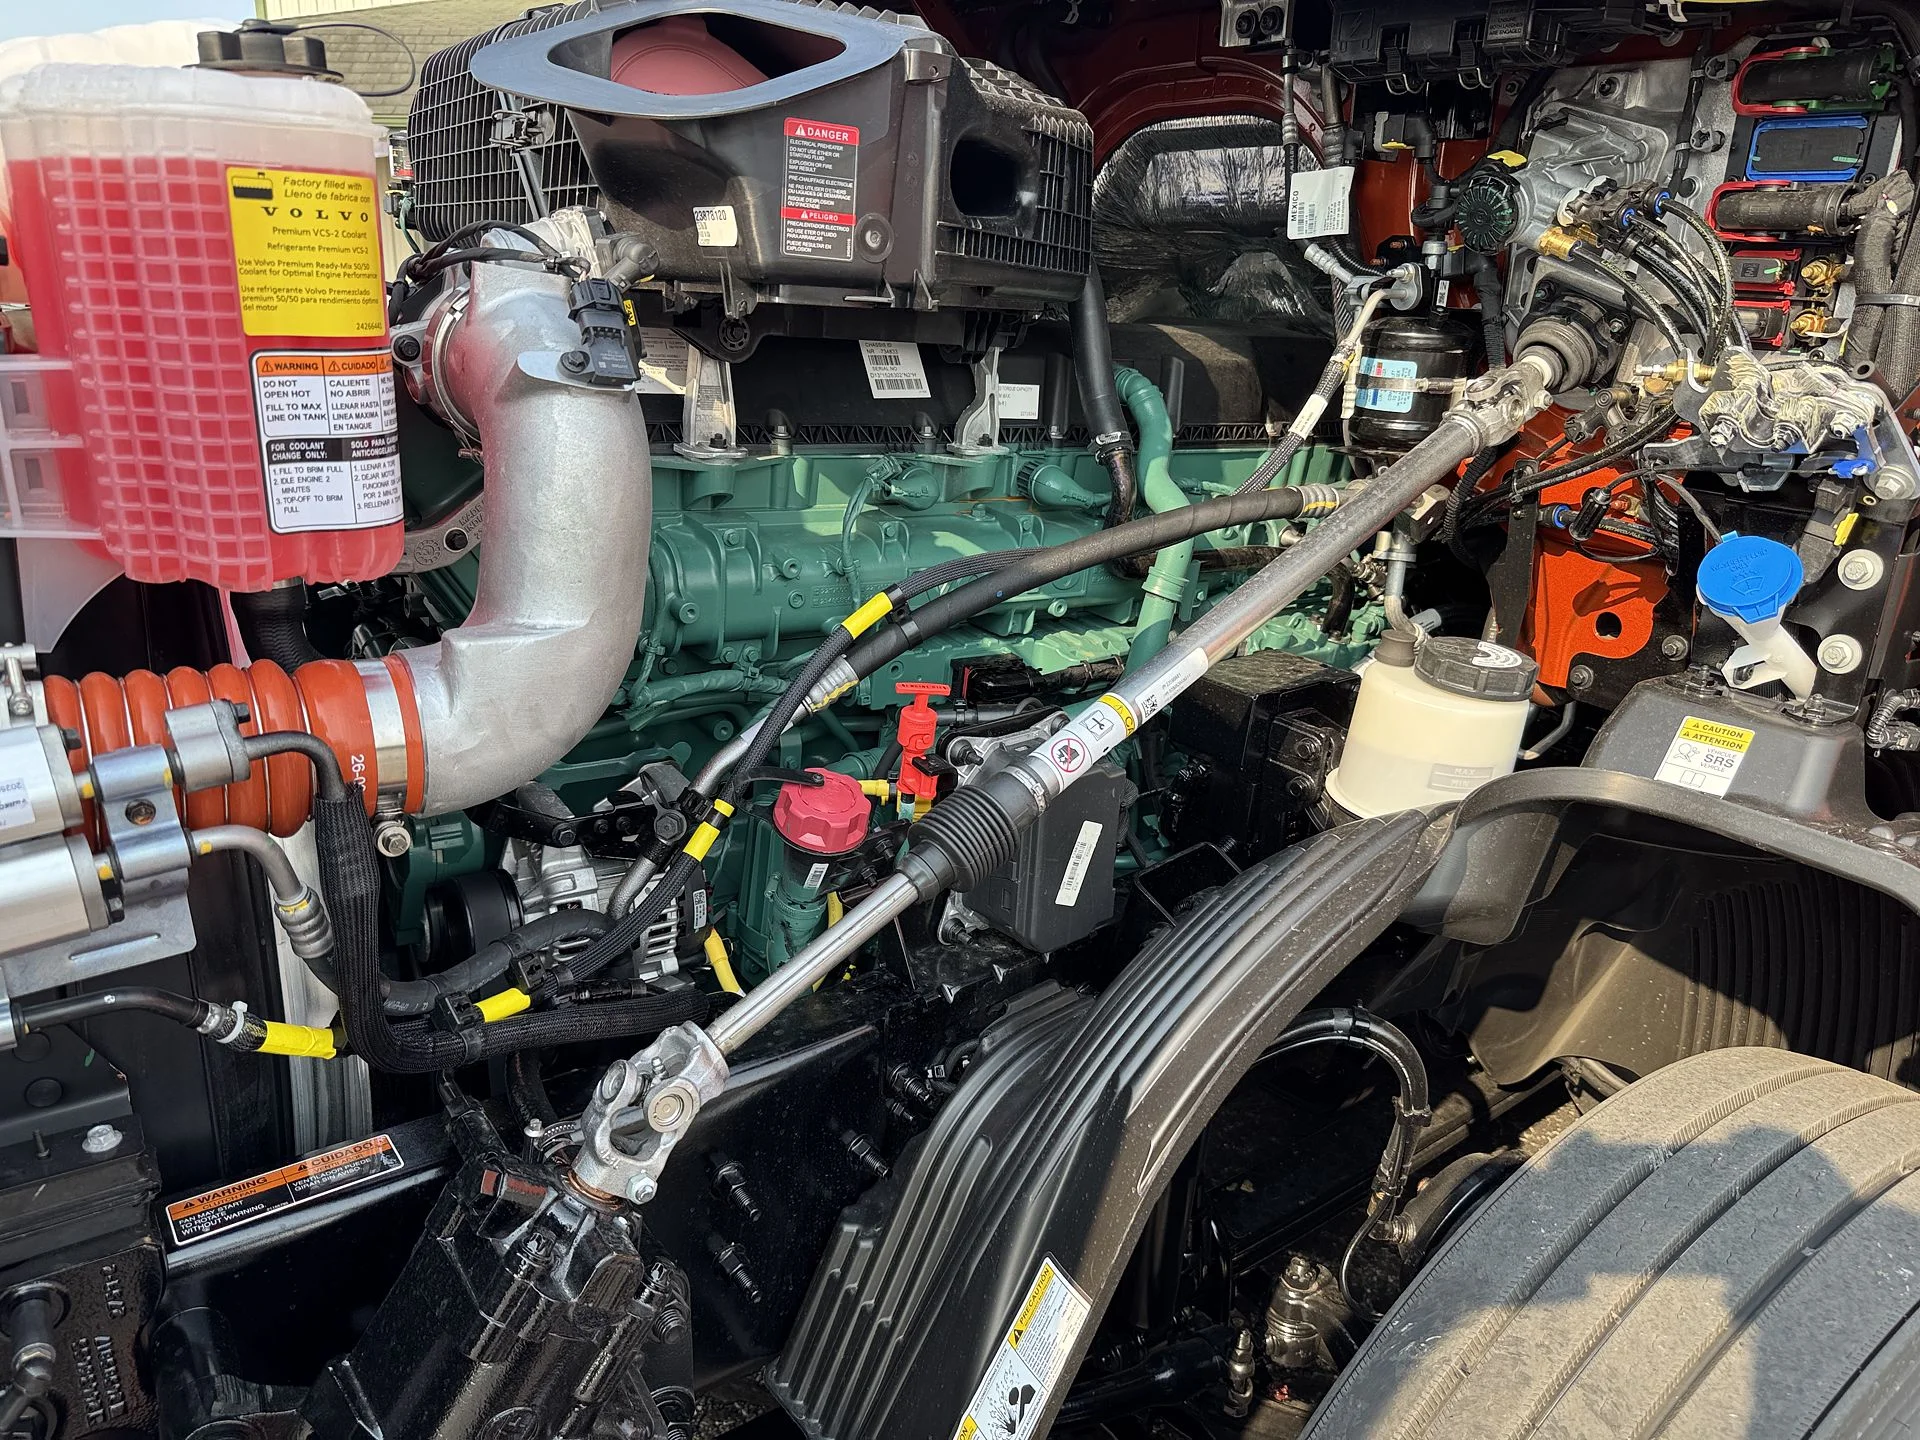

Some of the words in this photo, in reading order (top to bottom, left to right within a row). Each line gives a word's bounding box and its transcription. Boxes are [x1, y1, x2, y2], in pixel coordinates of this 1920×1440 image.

[808, 128, 848, 141] DANGER
[790, 139, 816, 147] ELECTRICAL
[817, 143, 843, 151] PREHEATER
[789, 159, 814, 167] EXPLOSION
[284, 177, 321, 188] Factory
[324, 178, 345, 189] filled
[348, 181, 362, 190] with
[285, 189, 312, 199] Lleno
[316, 191, 327, 200] de
[330, 193, 358, 202] fabrica
[1291, 190, 1299, 221] MEXICO
[262, 207, 368, 222] VOLVO
[809, 213, 838, 221] PELIGRO
[787, 220, 824, 229] PRECALENTADOR
[273, 227, 311, 236] Premium
[314, 229, 339, 237] VCS-2
[342, 231, 367, 239] Coolant
[268, 243, 316, 252] Refrigerante
[318, 245, 351, 253] Premium
[352, 246, 368, 254] VCS-2
[283, 269, 313, 278] Optimal
[316, 271, 341, 279] Engine
[257, 286, 304, 294] refrigerante
[276, 295, 298, 303] 50/50
[320, 297, 361, 305] rendimiento
[625, 304, 634, 322] 24V
[274, 362, 318, 370] WARNING
[342, 362, 376, 370] CUIDADO
[346, 422, 372, 430] TANQUE
[271, 443, 286, 451] FOR
[289, 442, 324, 450] COOLANT
[351, 440, 368, 448] SOLO
[371, 438, 385, 446] PARA
[272, 452, 301, 460] CHANGE
[361, 472, 379, 480] DEJAR
[282, 486, 310, 494] MINUTES
[363, 482, 389, 490] FUNCIONAR
[284, 496, 311, 504] TOP-OFF
[364, 500, 390, 509] RELLENAR
[284, 506, 299, 514] FULL
[1702, 724, 1744, 738] CAUTION
[1692, 733, 1743, 750] ATTENTION
[1704, 754, 1734, 768] SRS
[1701, 762, 1725, 772] VEHICLE
[1451, 779, 1469, 787] MIN
[311, 1142, 373, 1166] CUIDADO
[293, 1167, 343, 1186] VENTILADOR
[345, 1158, 372, 1169] PUEDE
[294, 1181, 321, 1192] GIRAR
[322, 1175, 336, 1183] SIN
[337, 1167, 360, 1177] AVISO
[198, 1176, 267, 1203] WARNING
[203, 1195, 238, 1210] CLUTCH
[240, 1189, 256, 1198] FAN
[179, 1216, 196, 1224] FAN
[197, 1210, 215, 1219] MAY
[217, 1201, 244, 1212] START
[181, 1222, 192, 1230] TO
[194, 1211, 227, 1225] ROTATE
[182, 1219, 221, 1236] WITHOUT
[224, 1203, 266, 1221] WARNING.
